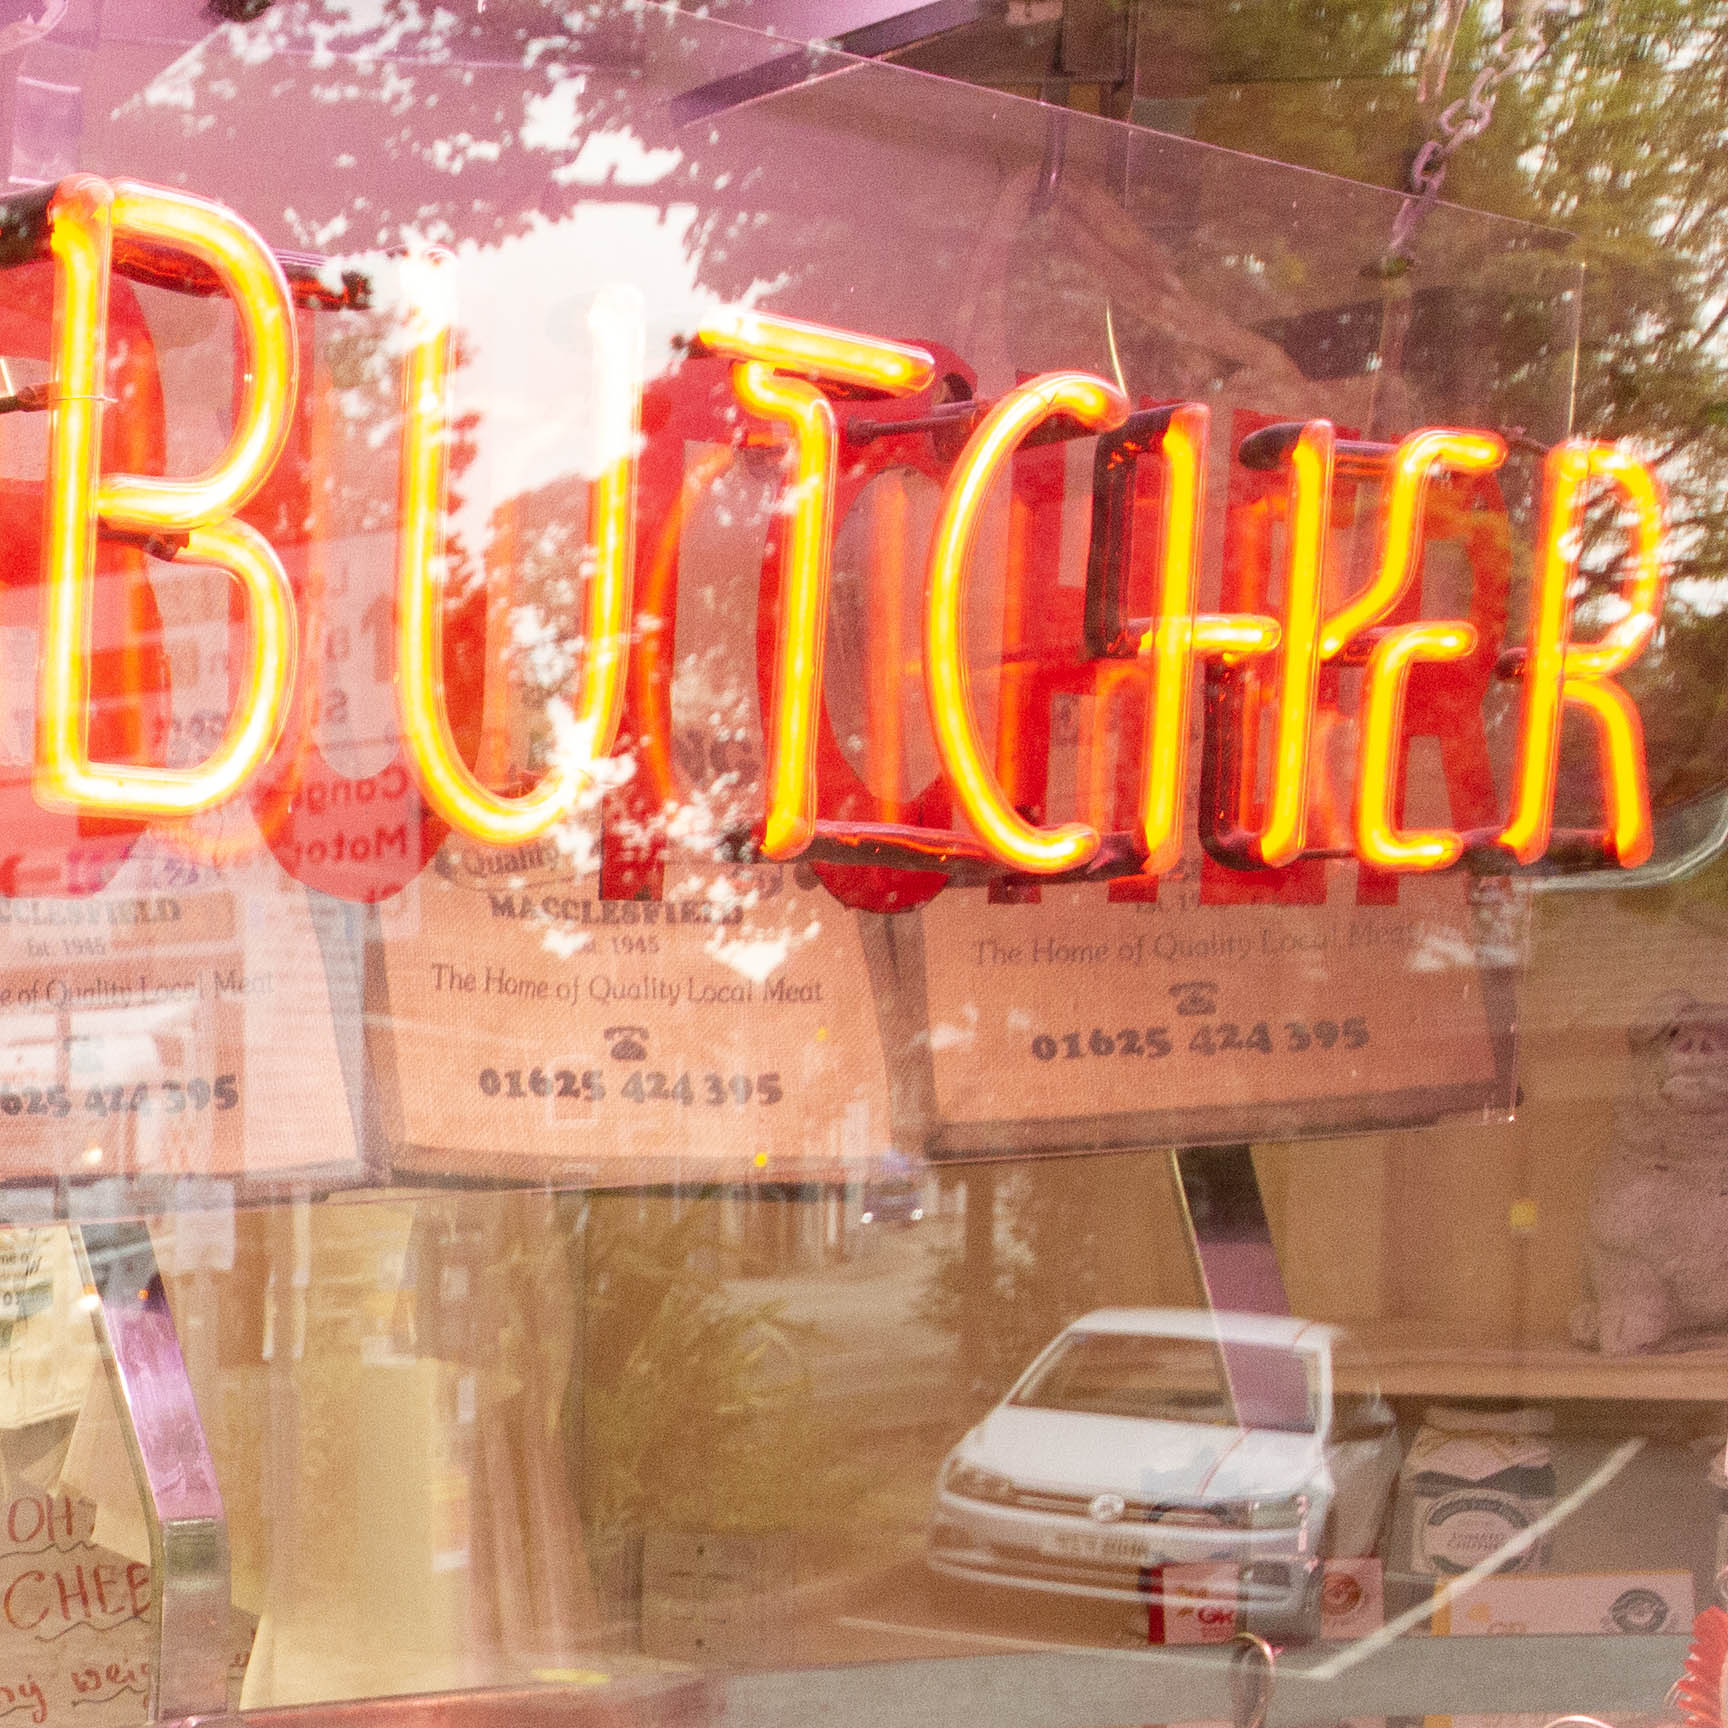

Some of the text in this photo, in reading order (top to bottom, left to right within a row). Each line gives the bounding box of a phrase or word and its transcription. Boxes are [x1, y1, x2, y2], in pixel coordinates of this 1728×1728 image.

[36, 172, 1665, 874] BUTCHER
[460, 843, 558, 878] Quality
[489, 895, 744, 926] MACCLESFIELD
[62, 935, 107, 957] 1945
[612, 935, 660, 955] 1945
[972, 925, 1337, 968] The Home of Quality Local
[18, 978, 43, 1013] of
[46, 977, 134, 1010] Quality
[141, 970, 204, 1003] Local
[213, 968, 274, 997] Meat
[431, 962, 823, 1008] The Home of Quality Local Meat
[1031, 1016, 1370, 1063] 01625 424 395
[84, 1085, 152, 1118] 424
[161, 1075, 239, 1112] 395
[479, 1067, 783, 1106] 01625 424 395
